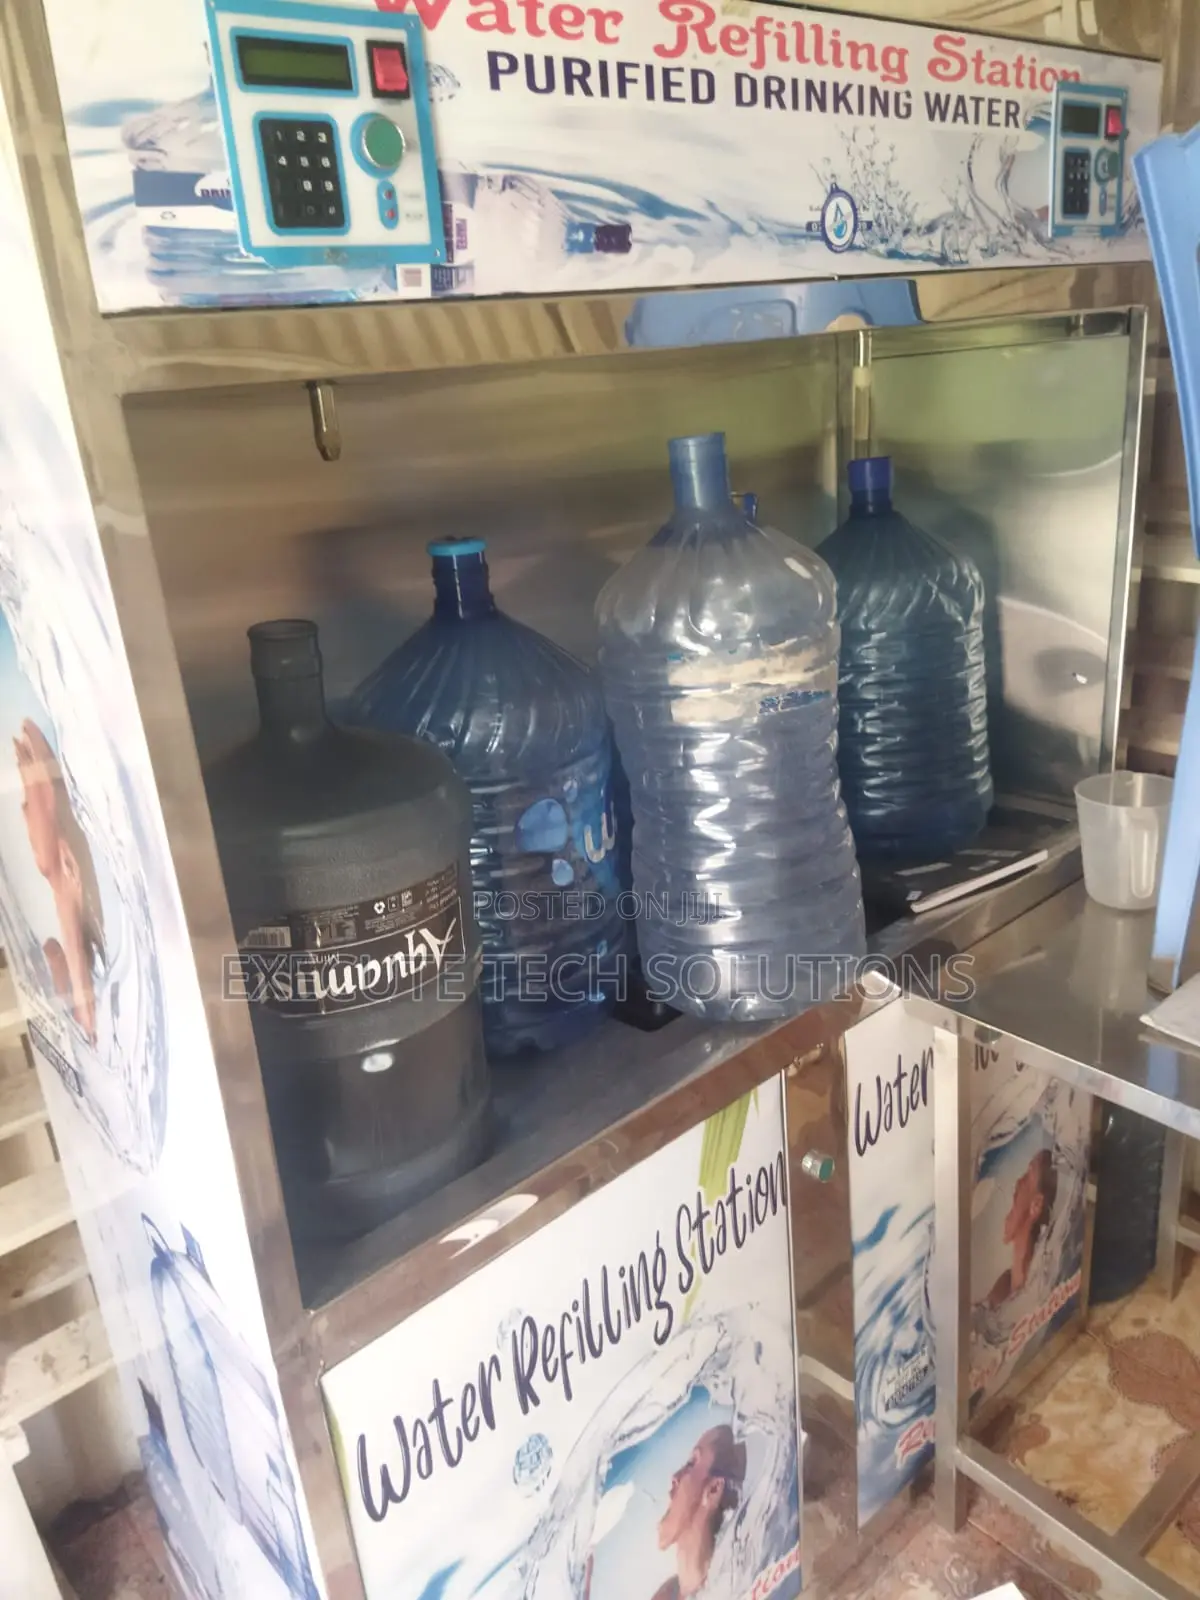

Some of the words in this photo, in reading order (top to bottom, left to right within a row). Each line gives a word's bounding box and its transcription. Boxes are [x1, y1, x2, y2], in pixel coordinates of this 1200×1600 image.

[373, 0, 621, 45] Water
[653, 0, 908, 84] Refilling
[488, 50, 716, 105] PURIFIED
[734, 72, 913, 120] DRINKING
[925, 91, 1021, 130] WATER
[357, 1354, 502, 1523] Water
[511, 1230, 674, 1415] Refilling
[675, 1150, 788, 1296] Station
